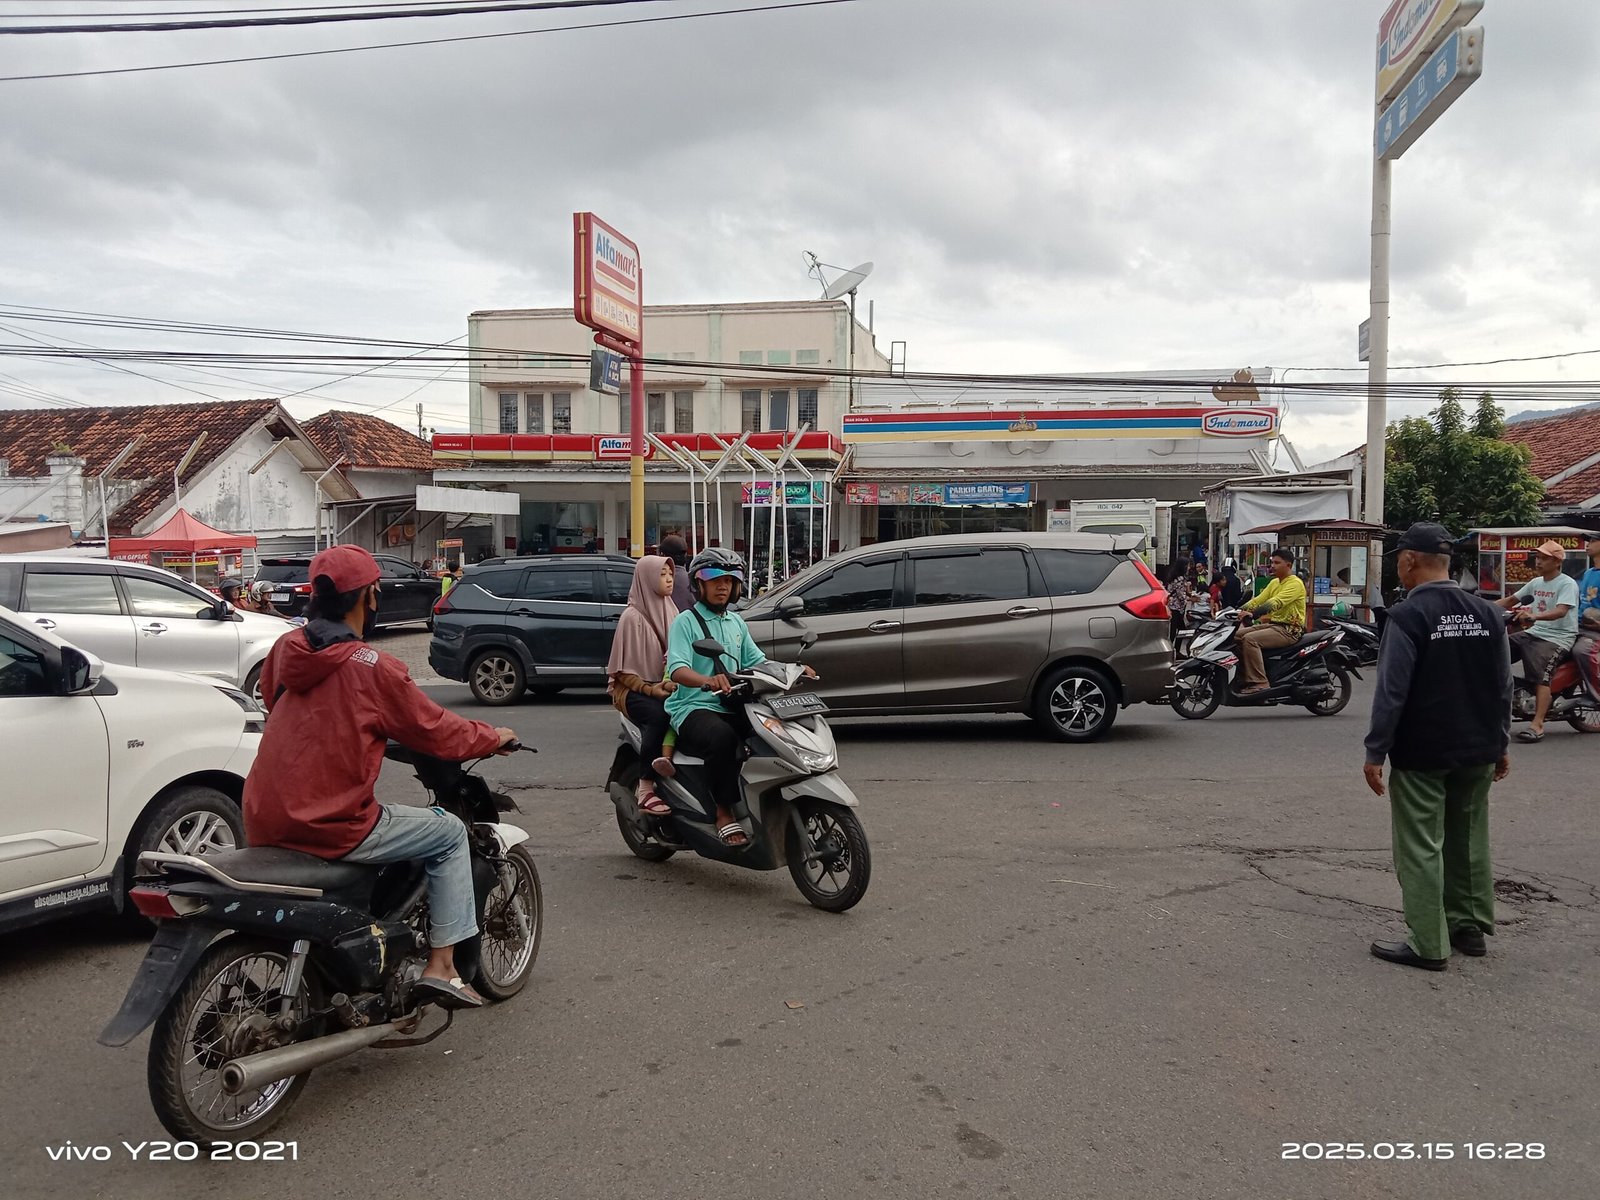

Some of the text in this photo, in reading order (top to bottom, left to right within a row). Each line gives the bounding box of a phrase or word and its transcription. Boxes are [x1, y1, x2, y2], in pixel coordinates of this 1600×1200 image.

[596, 232, 636, 278] Alfamart
[1208, 417, 1268, 428] Indomaret
[601, 440, 647, 448] Alfam
[949, 486, 976, 495] PARKIR
[977, 485, 1004, 494] GRATIS
[1513, 537, 1540, 549] TAHU
[1440, 614, 1475, 624] SATGAS
